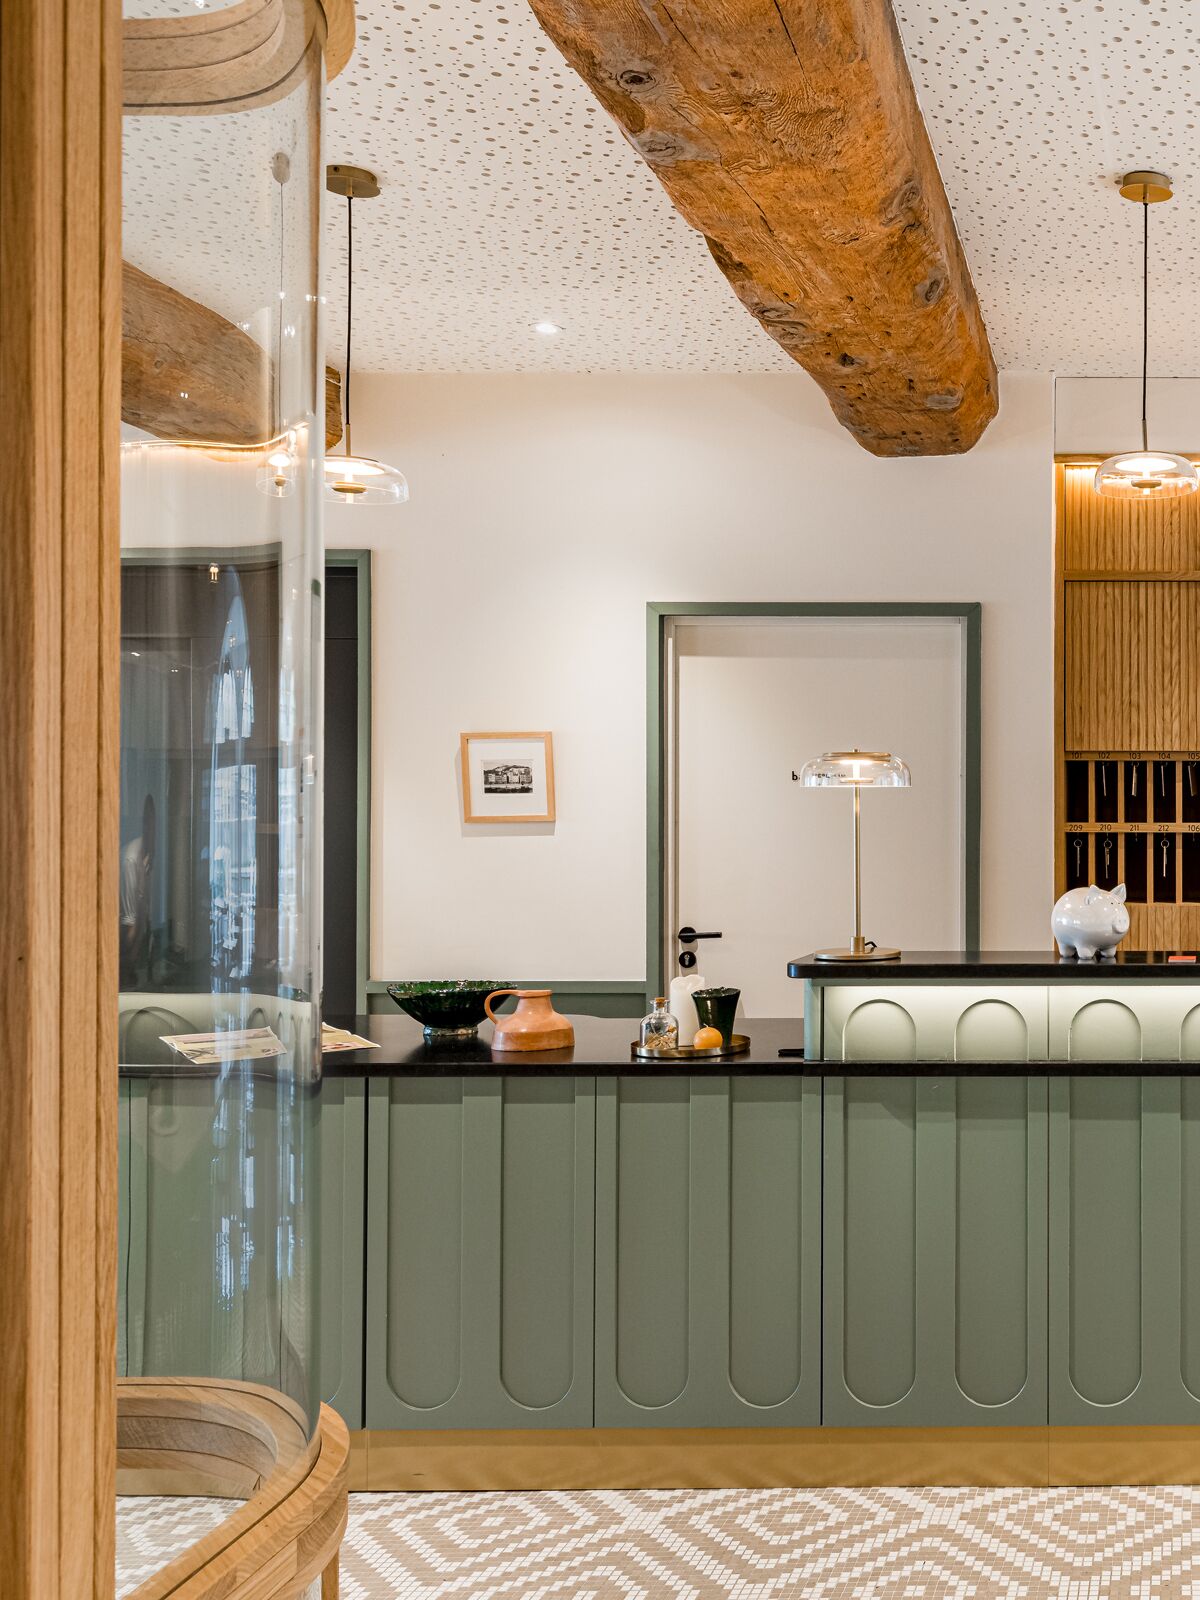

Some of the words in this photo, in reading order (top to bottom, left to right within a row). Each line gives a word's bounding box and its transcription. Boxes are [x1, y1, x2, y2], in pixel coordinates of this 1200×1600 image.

[1071, 752, 1082, 760] 101
[1098, 752, 1110, 760] 102
[1129, 752, 1141, 760] 103
[1158, 752, 1171, 760] 104
[1187, 752, 1200, 760] 105
[1069, 824, 1083, 832] 209
[1099, 824, 1112, 832] 210
[1129, 824, 1140, 832] 211
[1158, 824, 1170, 832] 212
[1187, 824, 1200, 832] 106
